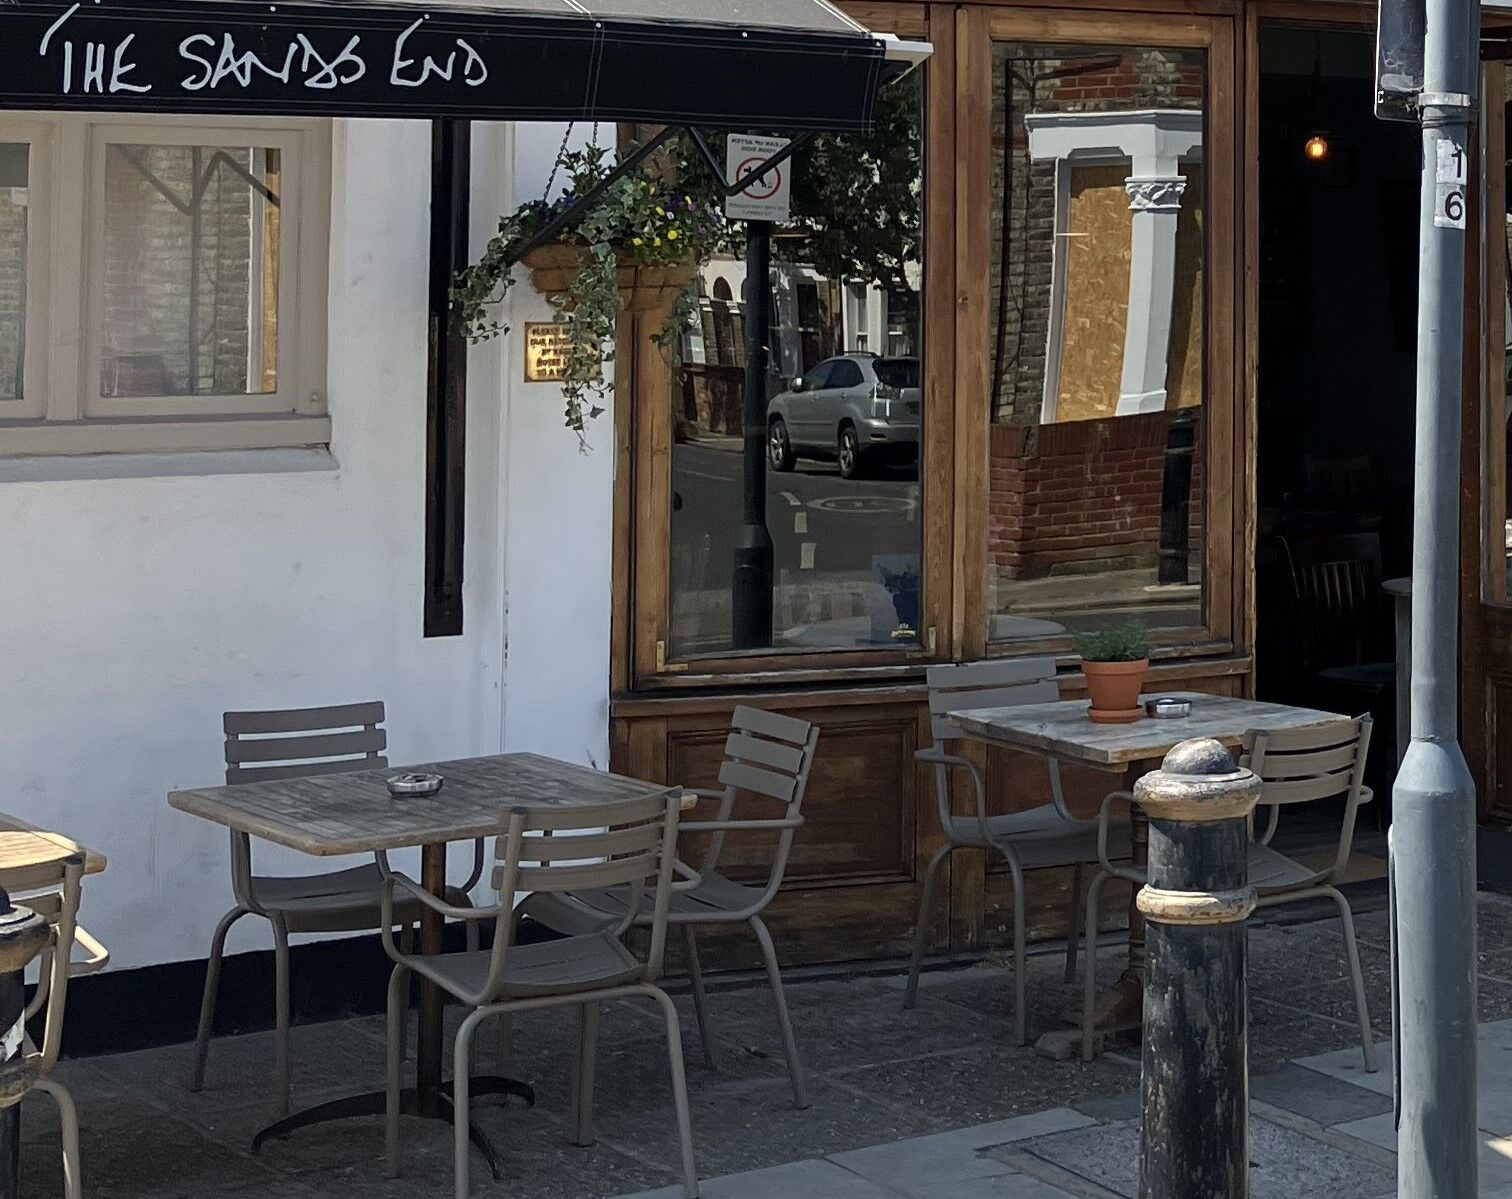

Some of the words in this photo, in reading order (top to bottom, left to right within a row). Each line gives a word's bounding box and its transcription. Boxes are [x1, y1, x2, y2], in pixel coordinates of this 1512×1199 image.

[39, 3, 152, 94] THE
[178, 31, 367, 90] SANDS
[390, 17, 489, 88] END
